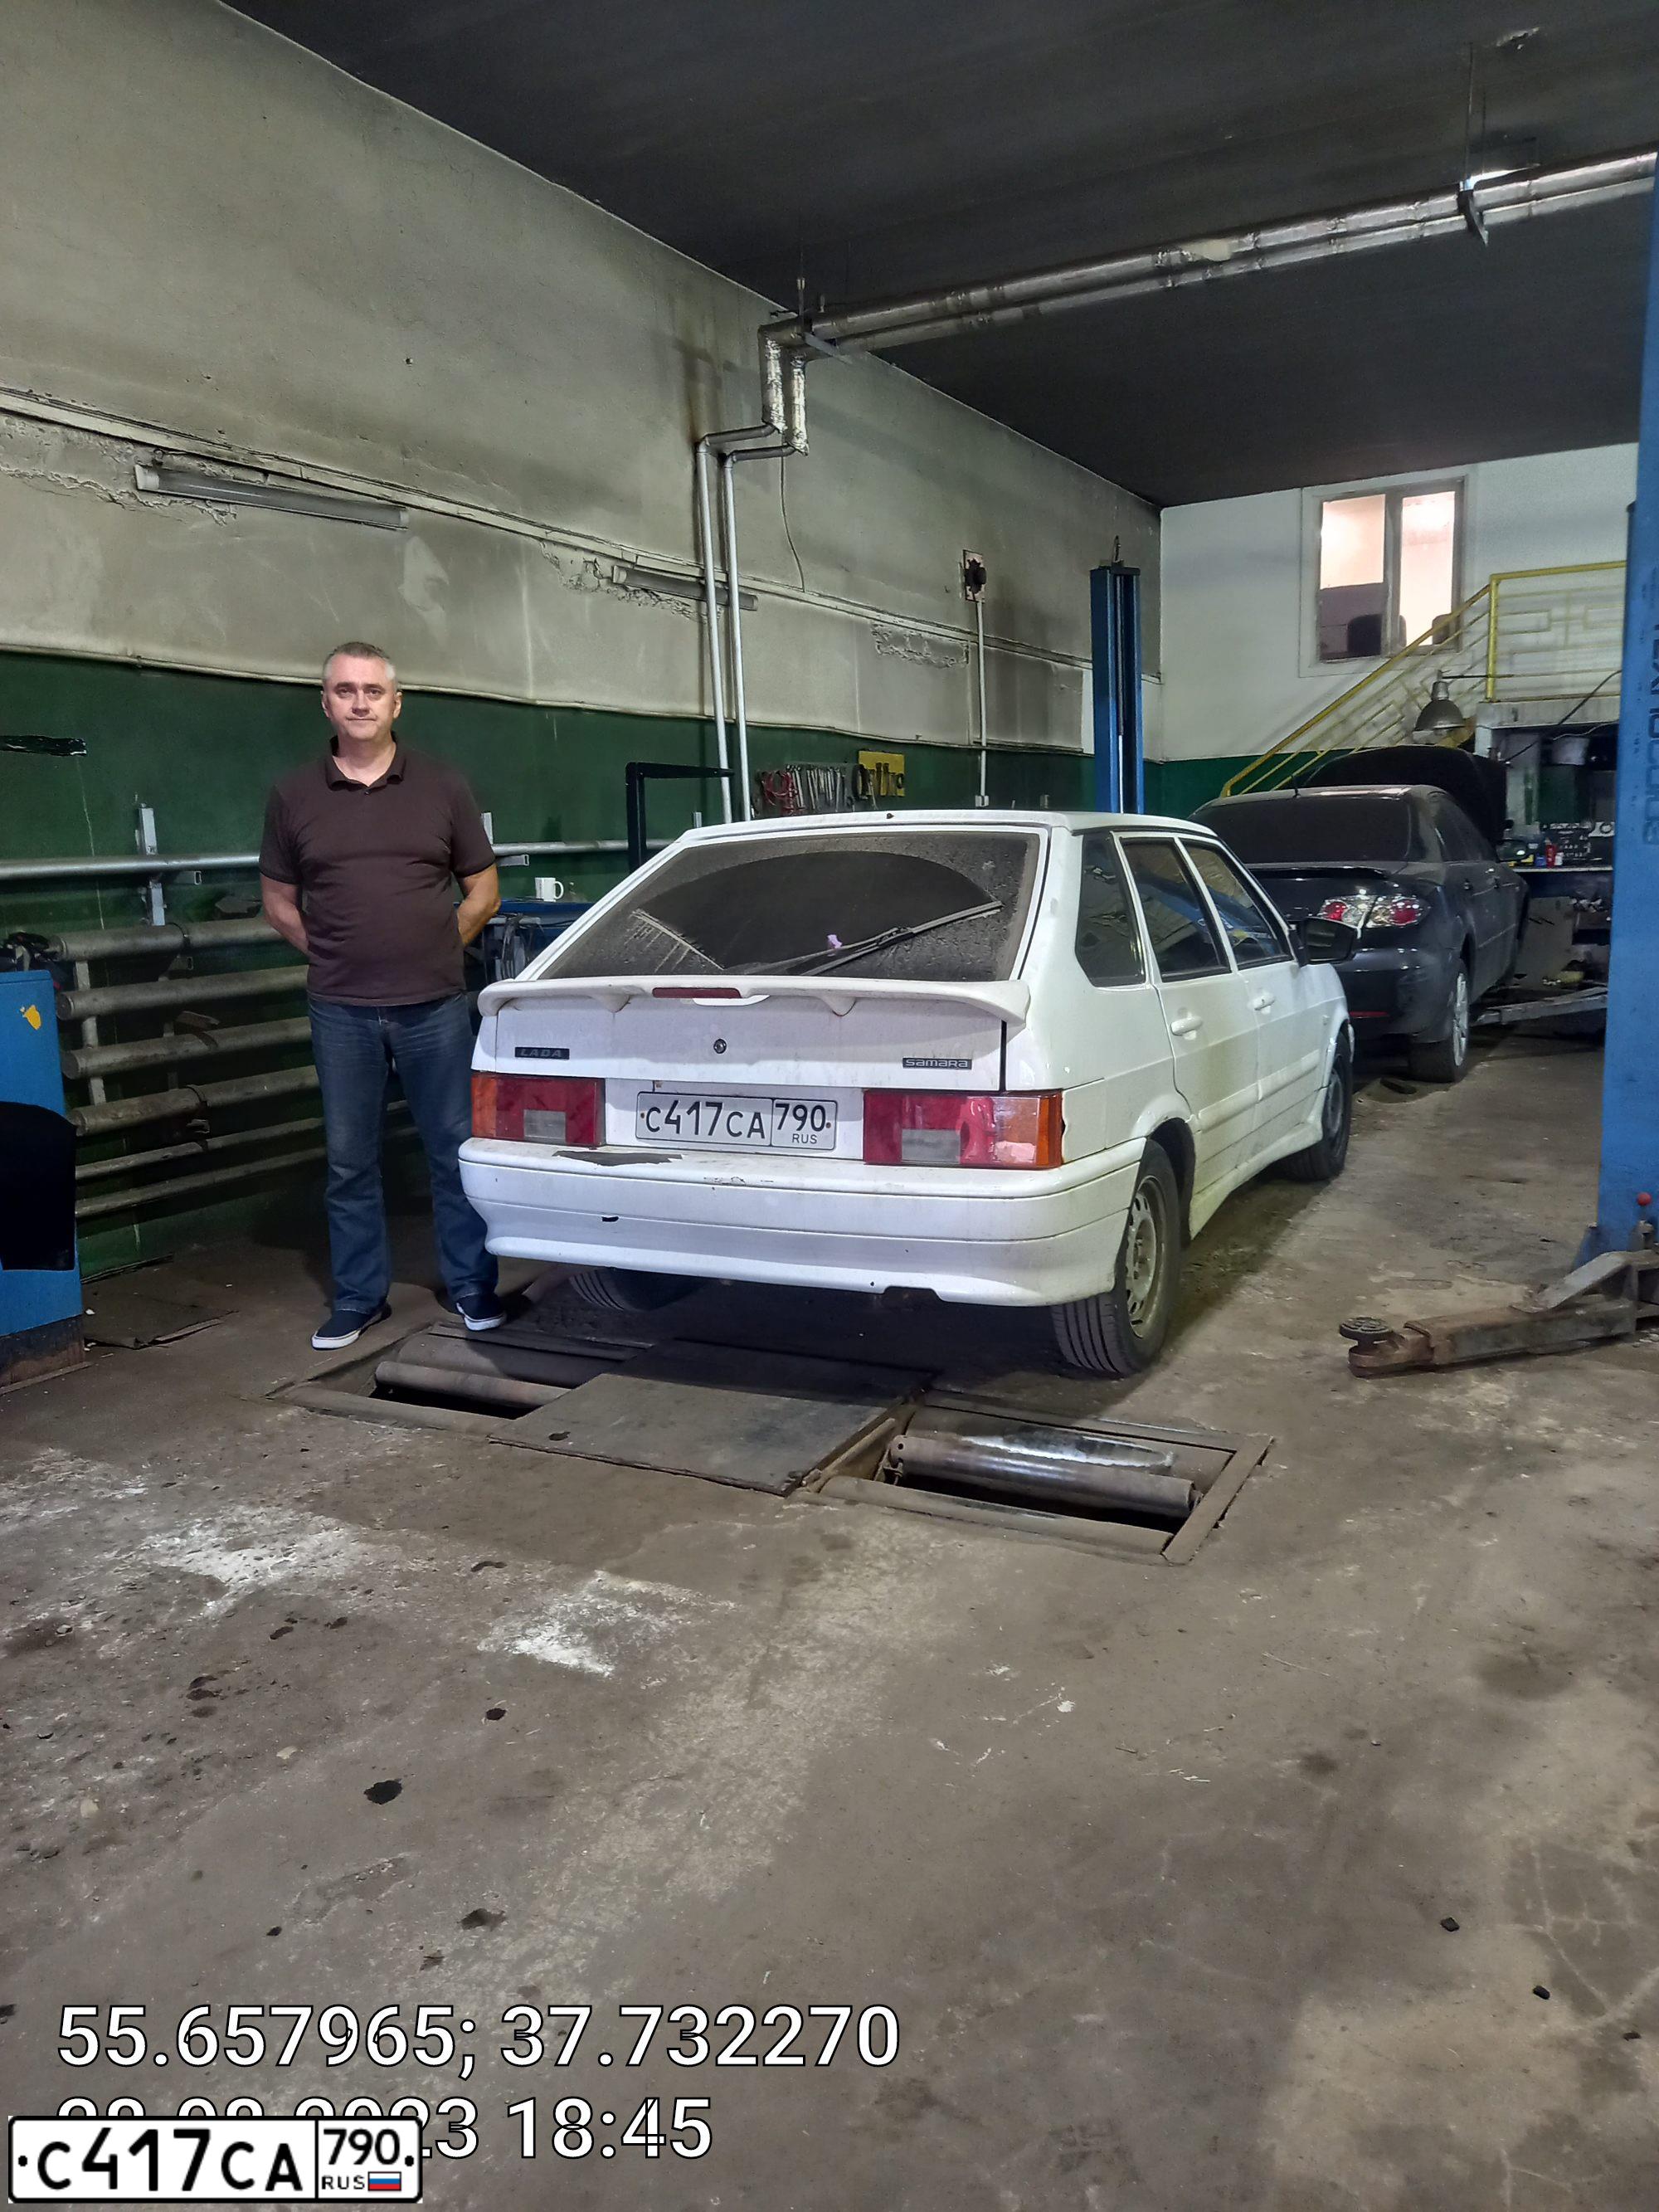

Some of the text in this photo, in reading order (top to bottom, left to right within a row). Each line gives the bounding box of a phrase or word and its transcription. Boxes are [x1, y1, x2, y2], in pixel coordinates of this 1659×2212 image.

[520, 1049, 562, 1058] LADA
[775, 1103, 827, 1132] 790
[791, 1133, 818, 1144] RUS
